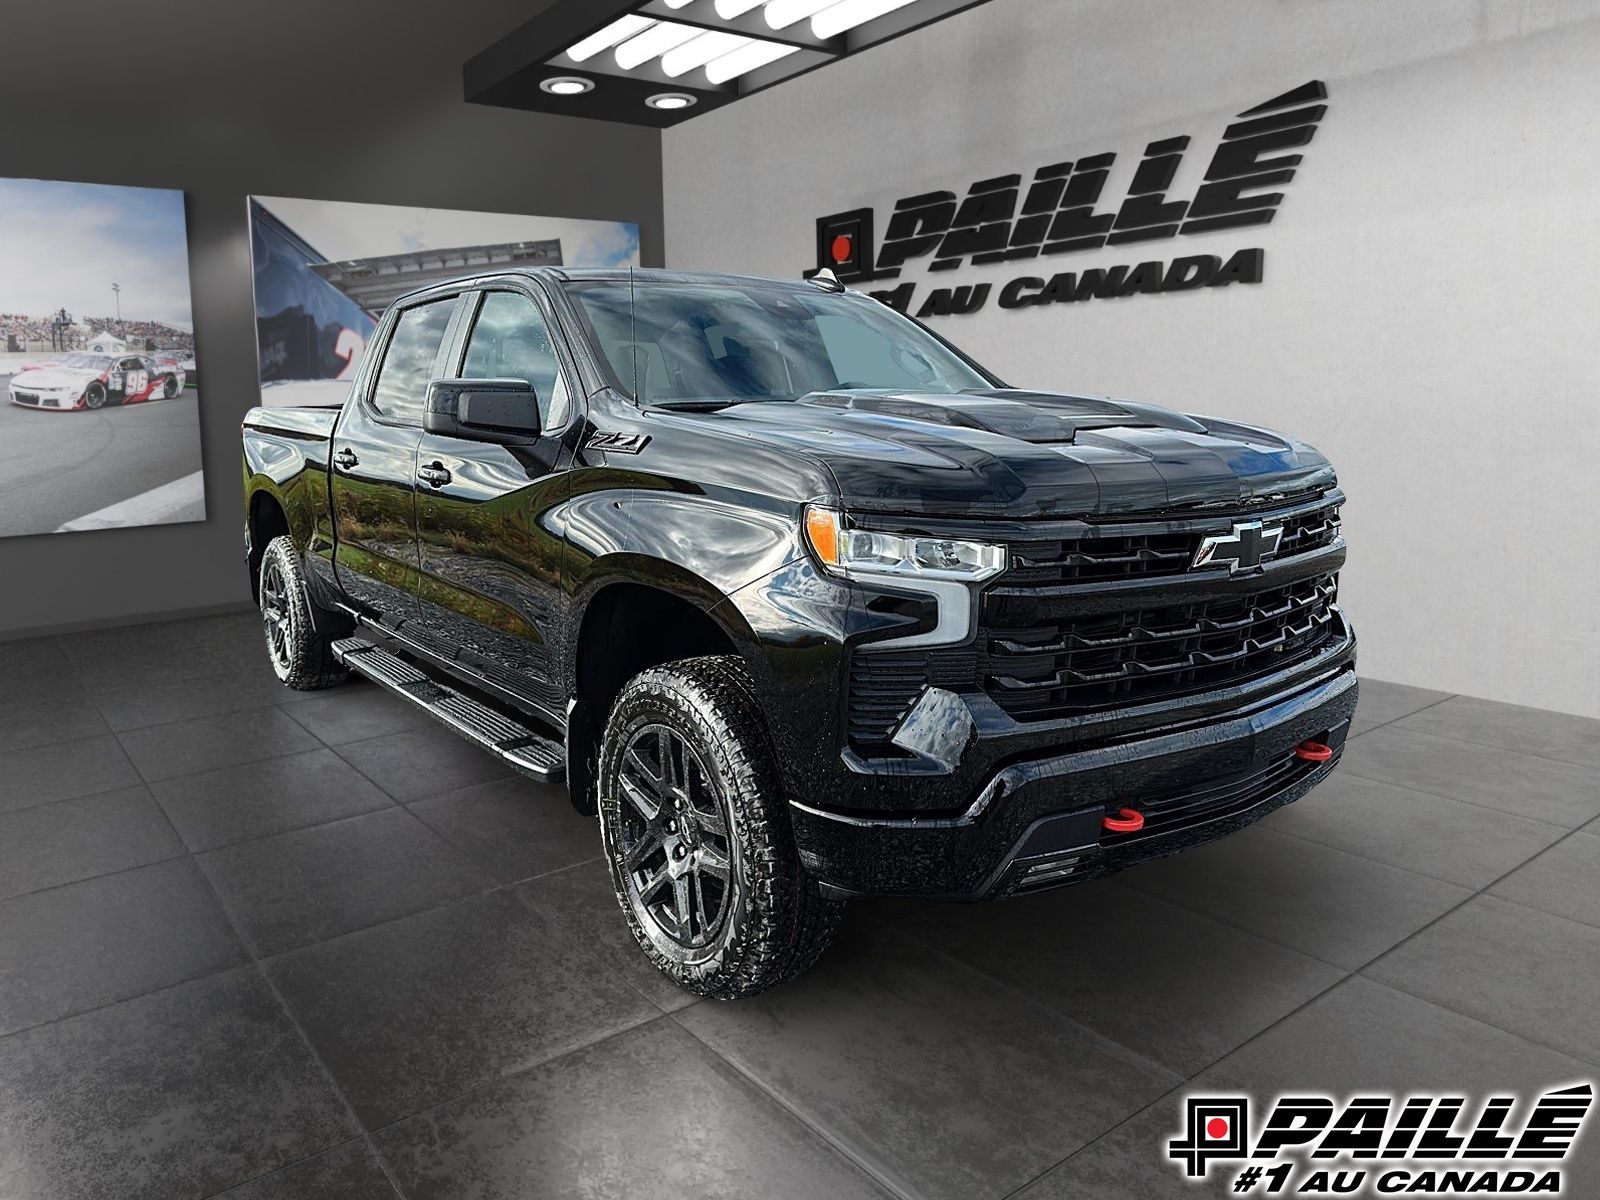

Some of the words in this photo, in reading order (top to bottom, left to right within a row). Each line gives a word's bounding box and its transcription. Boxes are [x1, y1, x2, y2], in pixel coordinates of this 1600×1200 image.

[876, 79, 1328, 273] PAILLÉ
[915, 282, 992, 318] AU
[998, 248, 1265, 310] CANADA
[125, 370, 149, 396] 96
